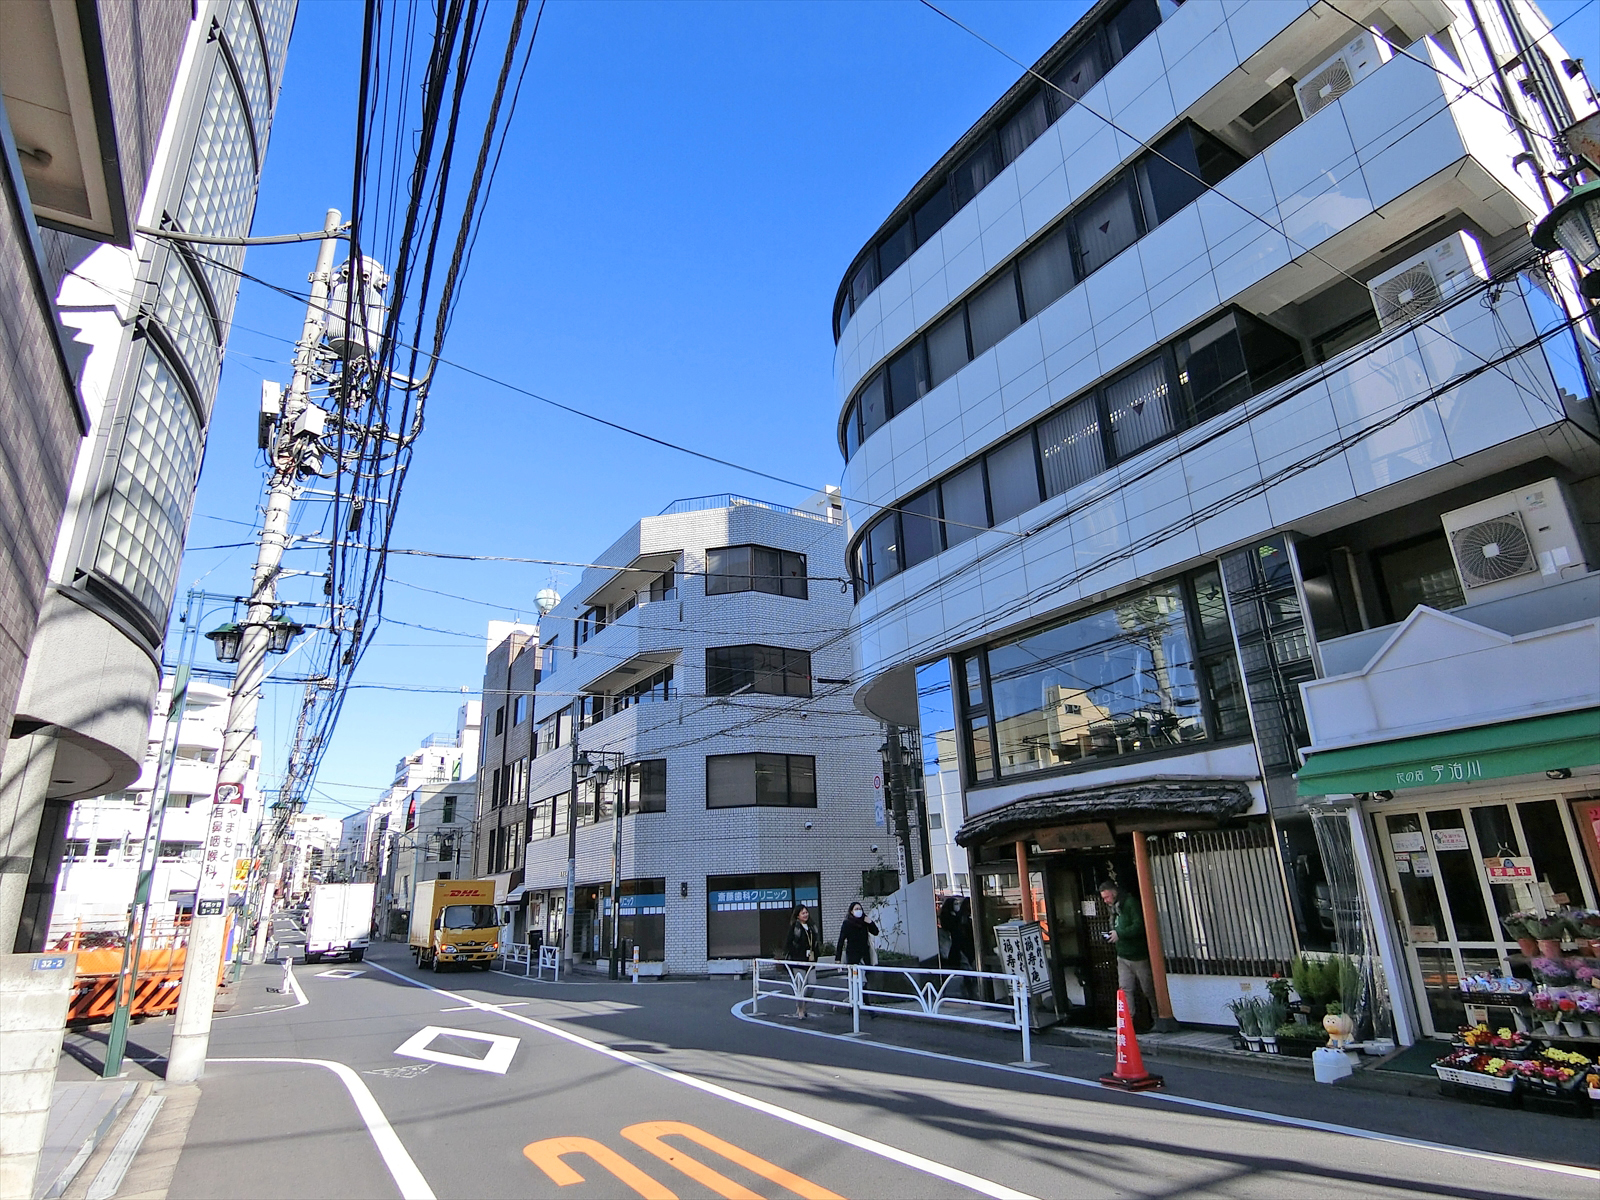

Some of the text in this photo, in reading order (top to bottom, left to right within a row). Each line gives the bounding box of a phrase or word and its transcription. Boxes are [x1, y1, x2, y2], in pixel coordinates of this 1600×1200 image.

[1431, 760, 1482, 782] 宇治川
[219, 807, 238, 863] やまもと
[205, 806, 225, 880] 耳鼻咽喉科
[1493, 867, 1527, 876] 営業中
[449, 889, 481, 897] DHL
[41, 959, 63, 968] 32-2
